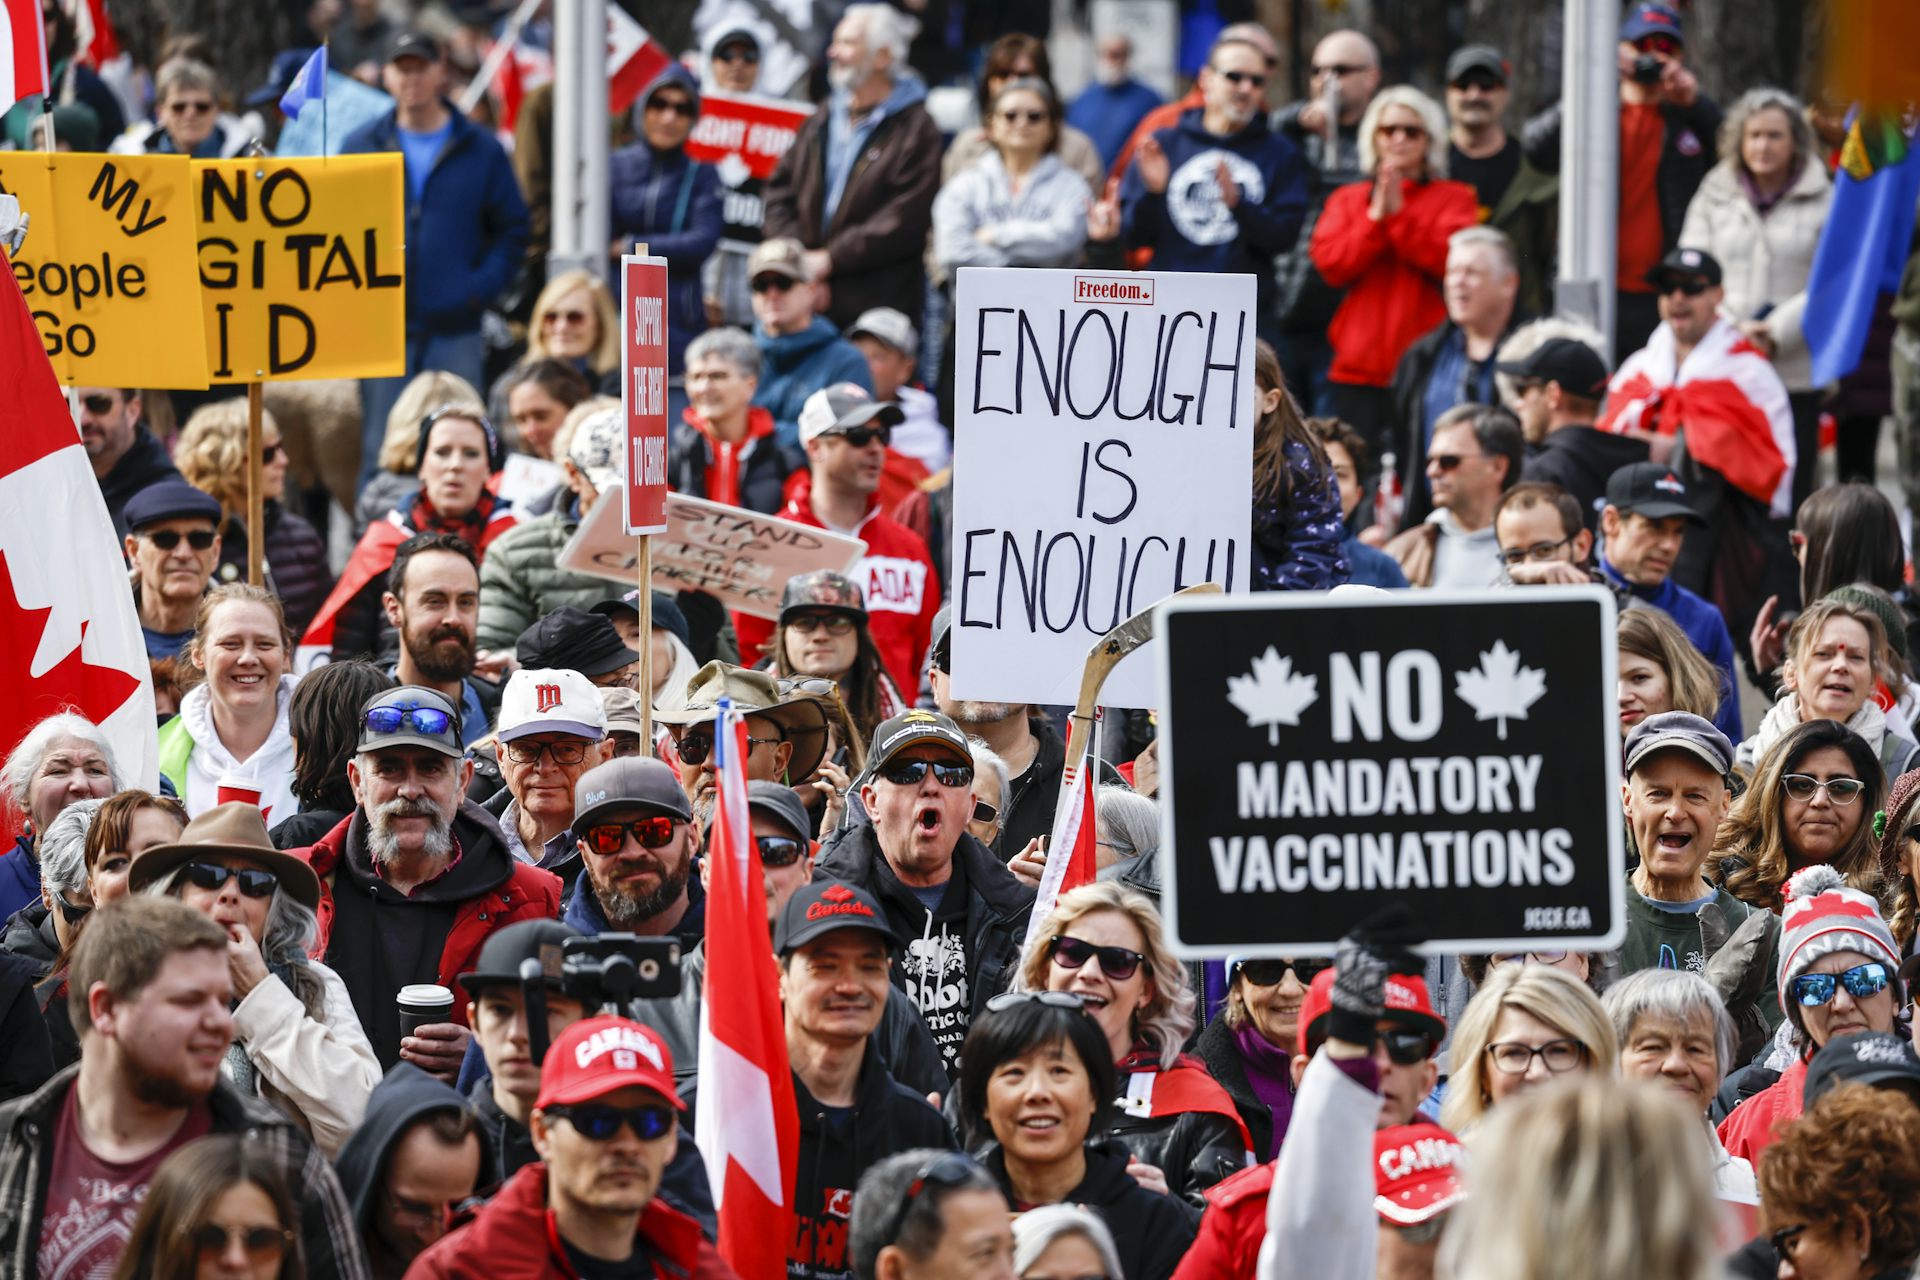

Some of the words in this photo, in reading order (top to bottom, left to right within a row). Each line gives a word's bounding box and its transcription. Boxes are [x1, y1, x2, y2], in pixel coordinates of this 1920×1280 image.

[88, 162, 167, 237] My
[202, 167, 311, 228] NO
[11, 252, 146, 311] eople
[197, 228, 402, 291] GITAL
[1079, 281, 1141, 299] Freedom
[214, 303, 316, 377] ID
[635, 296, 663, 346] SUPPORT
[633, 367, 647, 416] THE
[973, 307, 1246, 429] ENOUGH
[633, 436, 643, 487] TO
[1076, 439, 1138, 525] IS
[671, 504, 823, 549] STAND
[868, 566, 919, 605] ADA
[1329, 649, 1444, 743] NO
[1237, 754, 1543, 819] MANDATORY
[1209, 828, 1575, 893] VACCINATIONS
[806, 901, 875, 921] Canada
[905, 977, 970, 1012] Root
